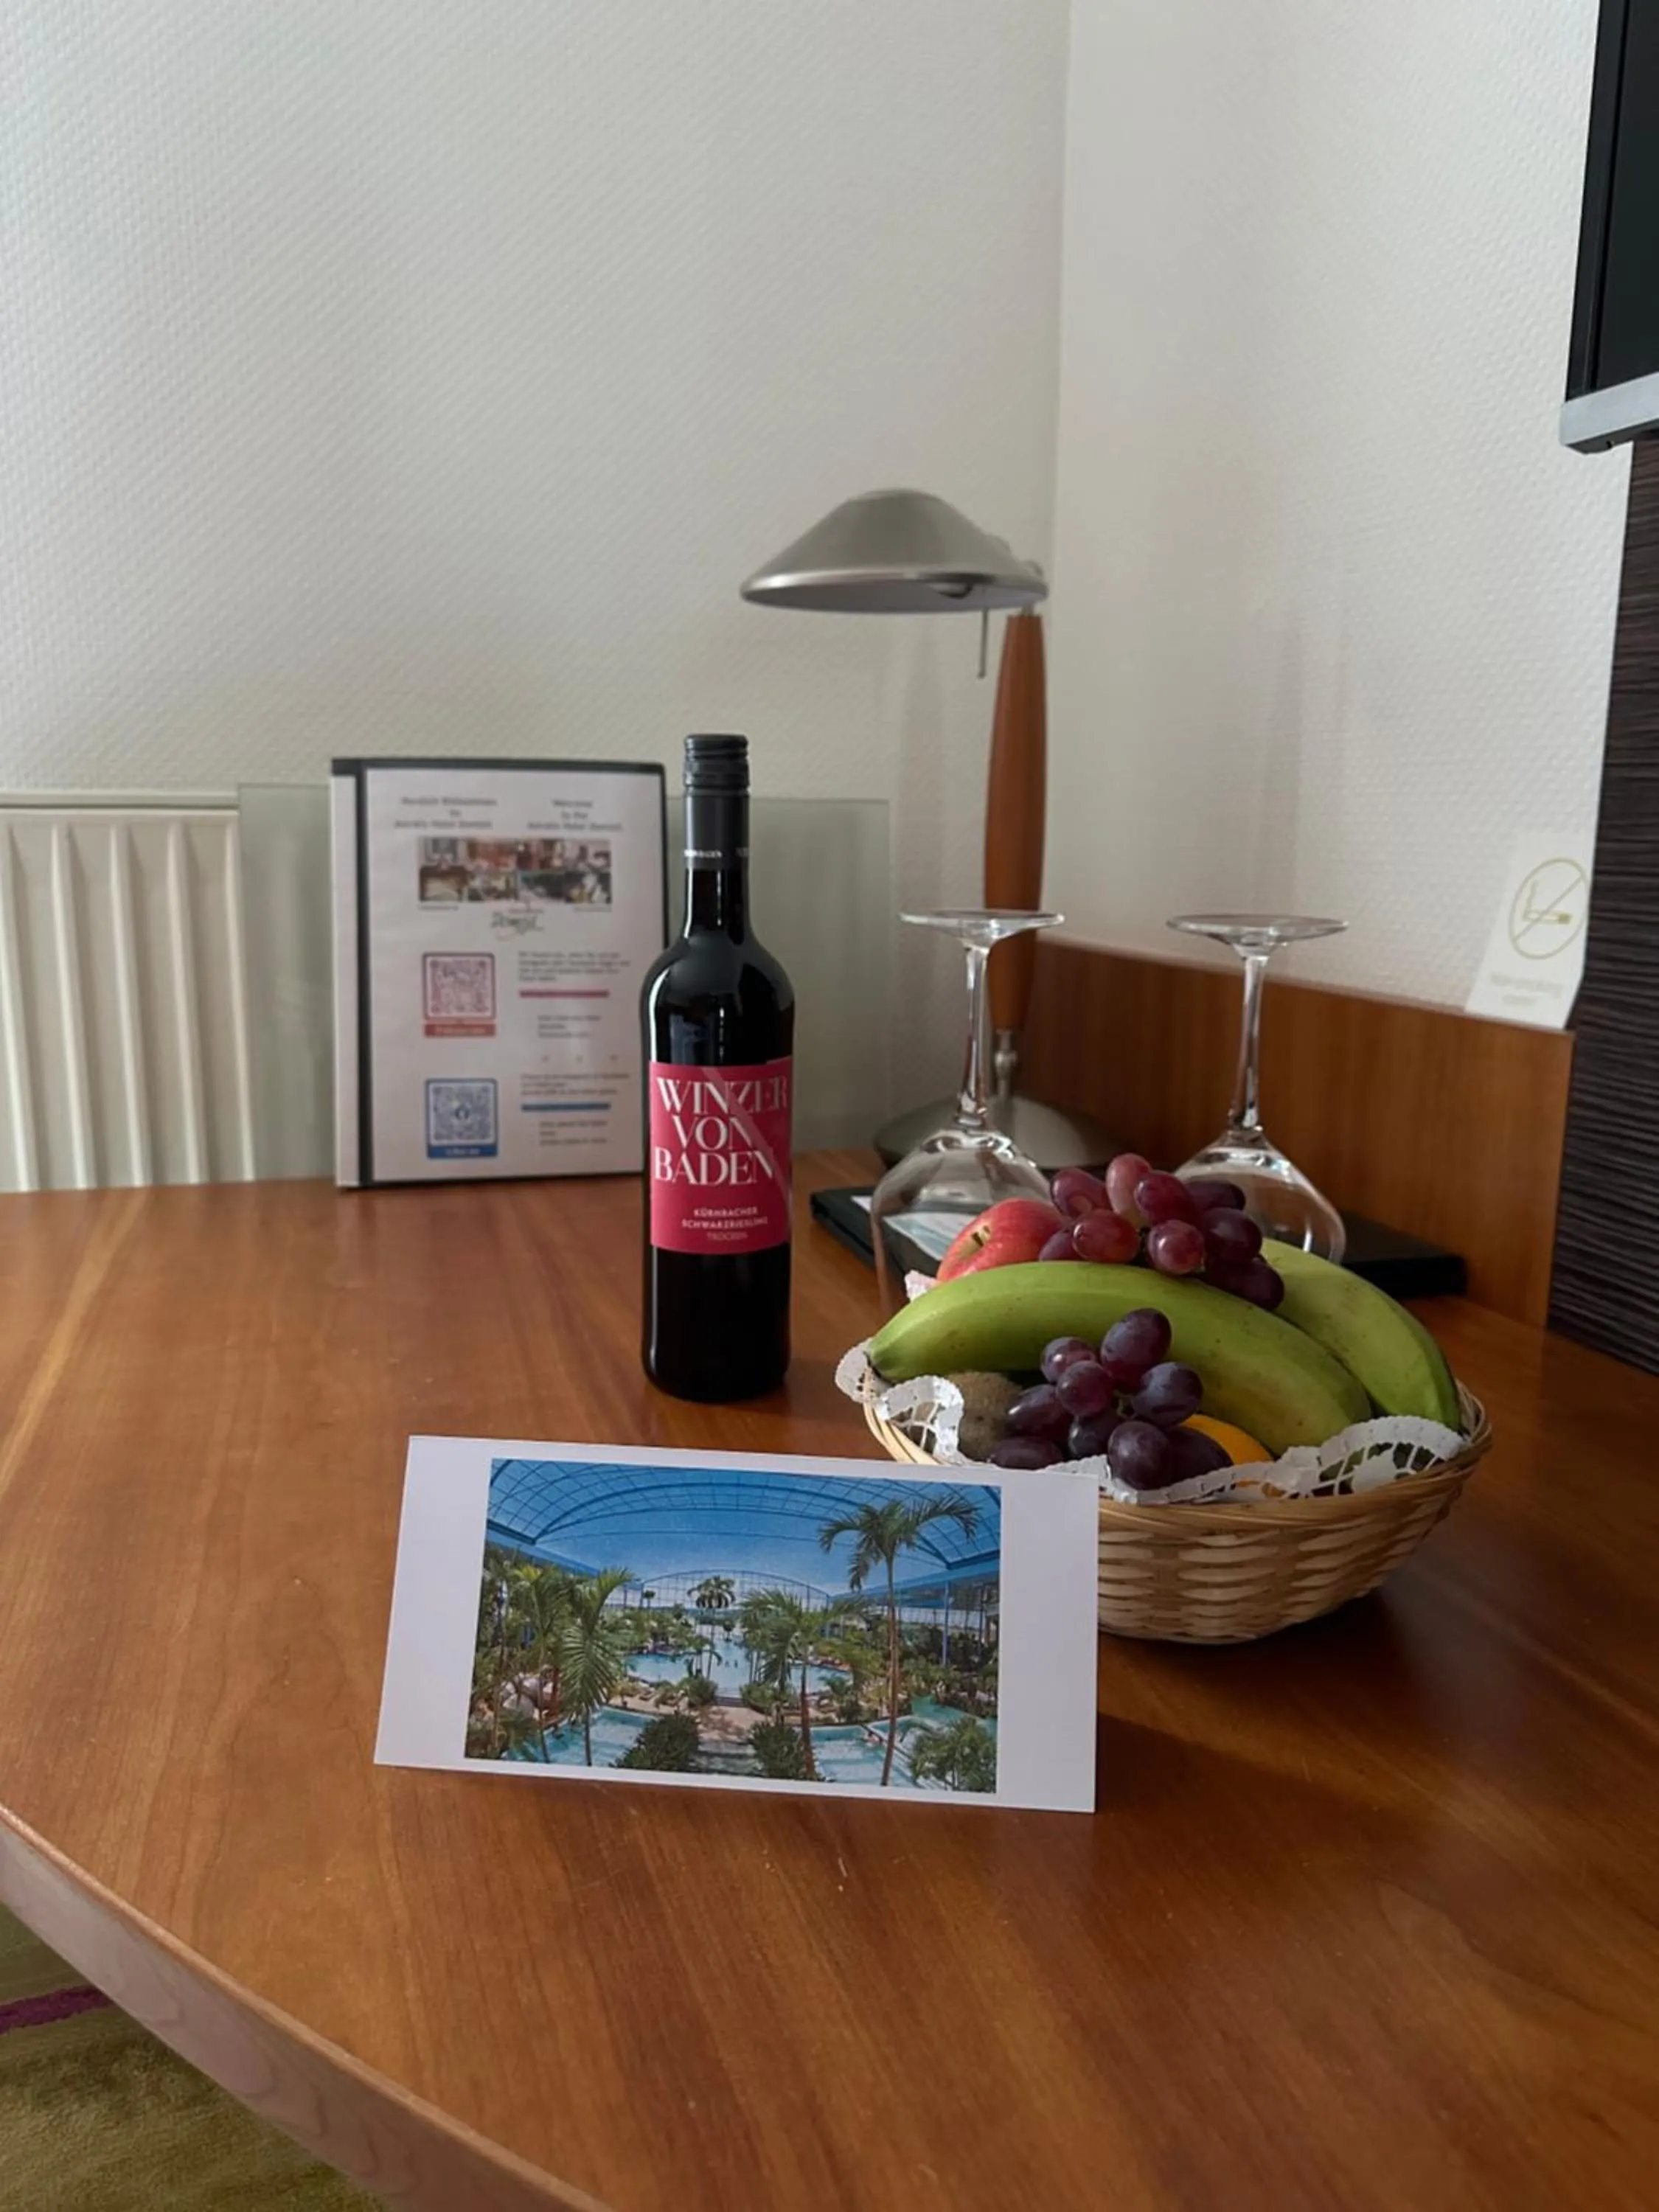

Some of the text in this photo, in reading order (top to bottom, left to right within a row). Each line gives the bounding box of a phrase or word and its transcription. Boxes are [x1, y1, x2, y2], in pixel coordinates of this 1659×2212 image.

[656, 1076, 787, 1114] WINZER
[672, 1114, 754, 1151] VON
[654, 1146, 775, 1186] BADEN
